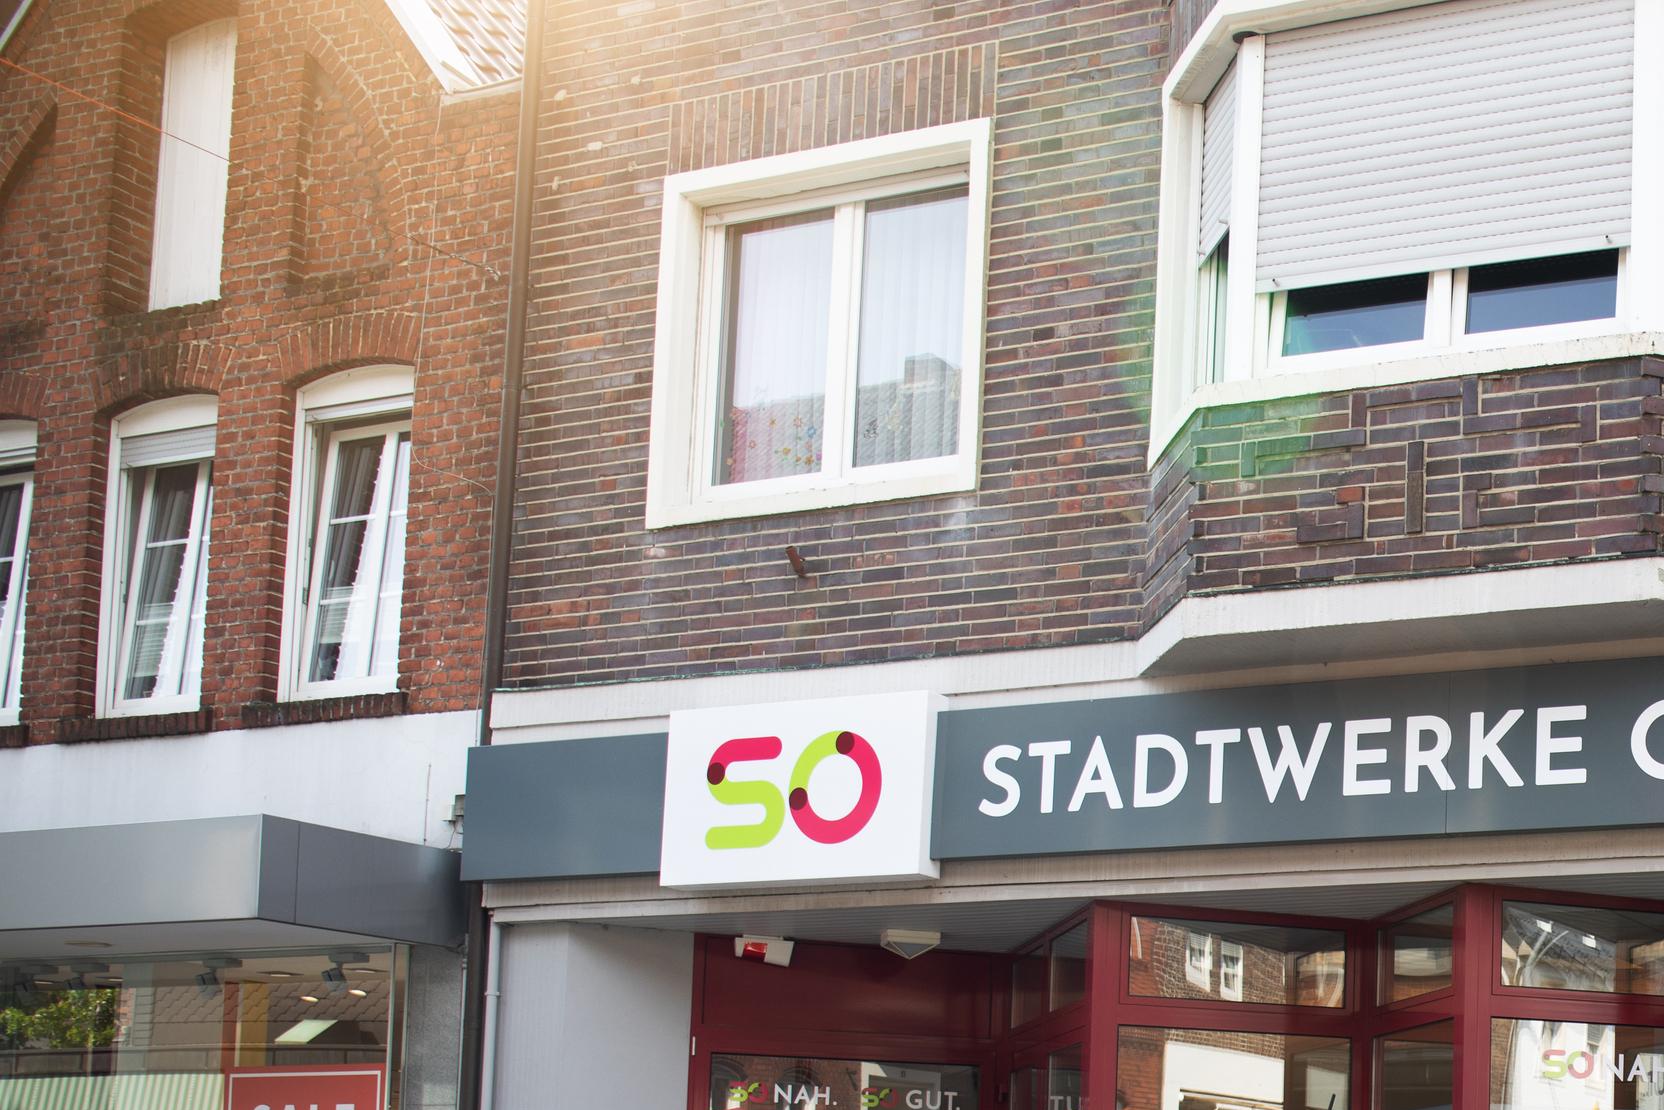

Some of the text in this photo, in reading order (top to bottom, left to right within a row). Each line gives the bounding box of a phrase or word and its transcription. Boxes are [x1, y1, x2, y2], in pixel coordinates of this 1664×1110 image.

[705, 730, 882, 850] SO
[978, 704, 1588, 818] STADTWERKE
[773, 1083, 838, 1106] NAH.
[1542, 1049, 1595, 1080] SO
